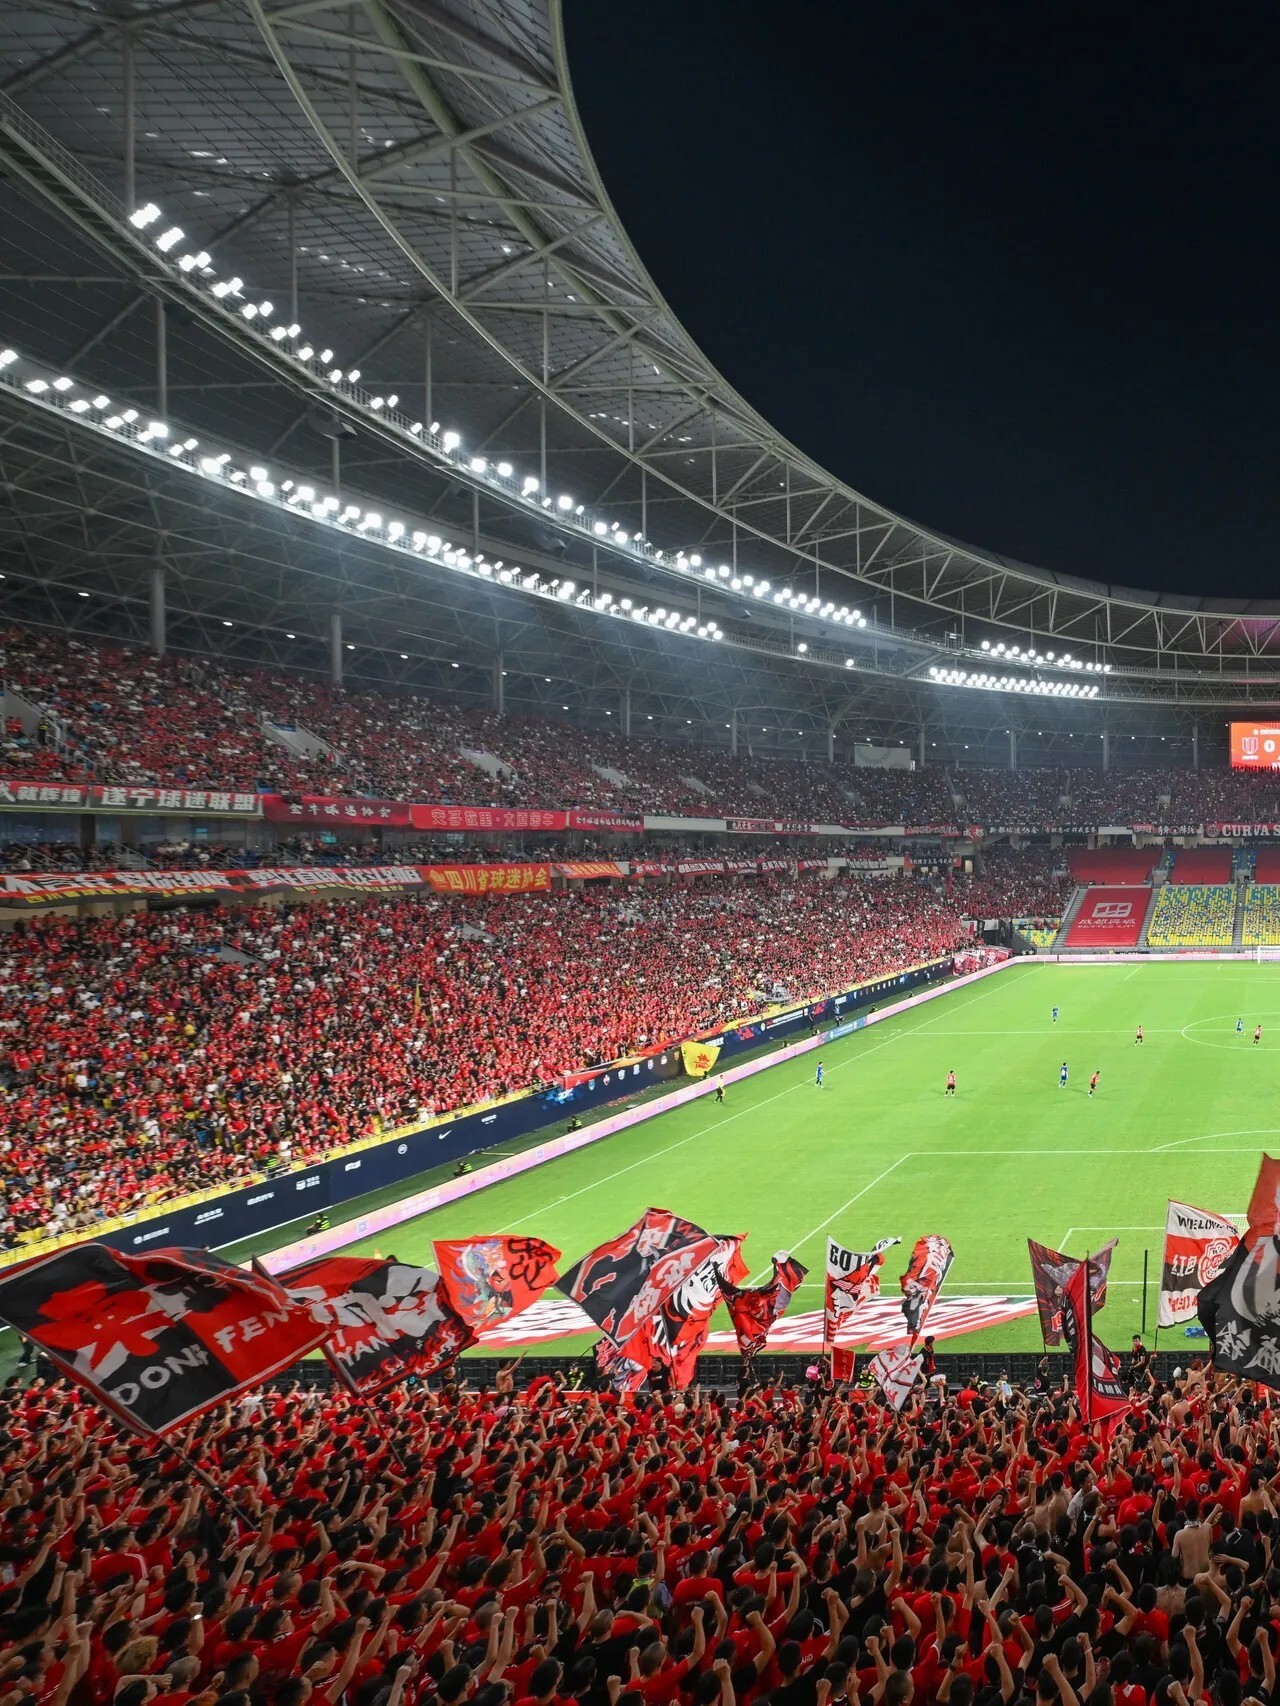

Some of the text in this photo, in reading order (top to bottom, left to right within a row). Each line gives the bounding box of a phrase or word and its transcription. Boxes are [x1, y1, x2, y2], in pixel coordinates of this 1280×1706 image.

[102, 787, 255, 811] 遂宁球迷联盟
[1222, 823, 1270, 837] CURVA
[444, 868, 548, 892] 四川省球迷协会
